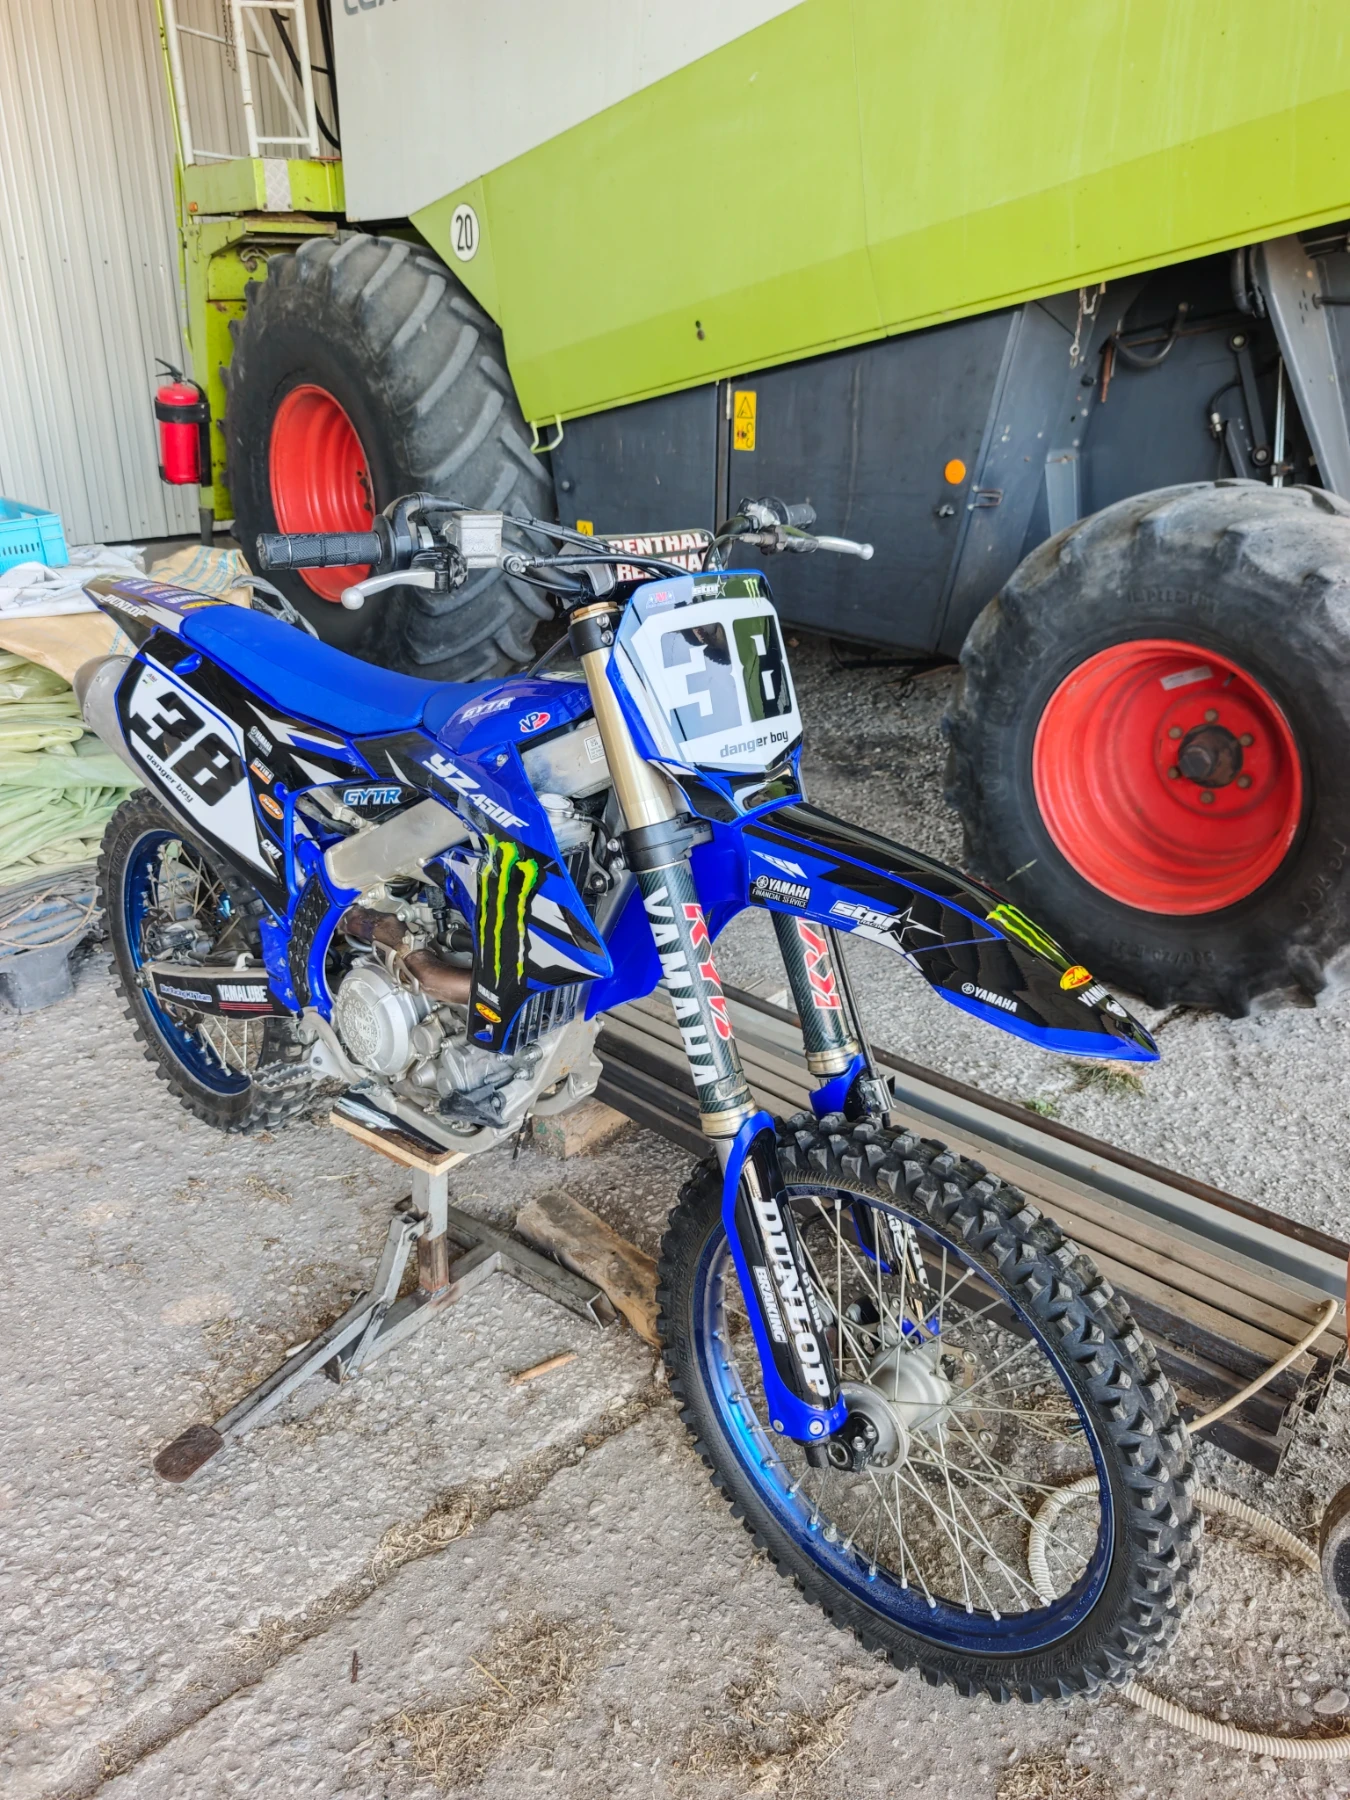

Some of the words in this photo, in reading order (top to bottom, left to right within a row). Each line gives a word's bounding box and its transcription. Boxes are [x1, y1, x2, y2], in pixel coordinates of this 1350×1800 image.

[456, 214, 473, 251] 20
[101, 594, 148, 618] DUNLOP
[660, 615, 792, 742] 38
[461, 697, 516, 718] GYTR
[130, 691, 248, 807] 38
[720, 737, 769, 758] danger
[771, 729, 789, 744] boy
[146, 753, 177, 786] danger
[176, 782, 194, 804] boy
[343, 786, 402, 806] GYTR
[469, 793, 529, 828] 450F
[752, 888, 782, 903] FINANCIAL
[782, 894, 808, 909] SERVICE
[768, 877, 811, 900] YAMAHA
[829, 900, 902, 928] star
[859, 918, 889, 932] RACING
[681, 903, 736, 1041] KYB
[796, 916, 843, 1010] KY
[217, 984, 268, 1003] YAMALUBE
[643, 886, 719, 1086] YAMAHA
[974, 987, 1018, 1013] YAMAHA
[754, 1198, 831, 1398] DUNLOP
[755, 1268, 787, 1342] BRAKING
[801, 1271, 824, 1332] CYCRA
